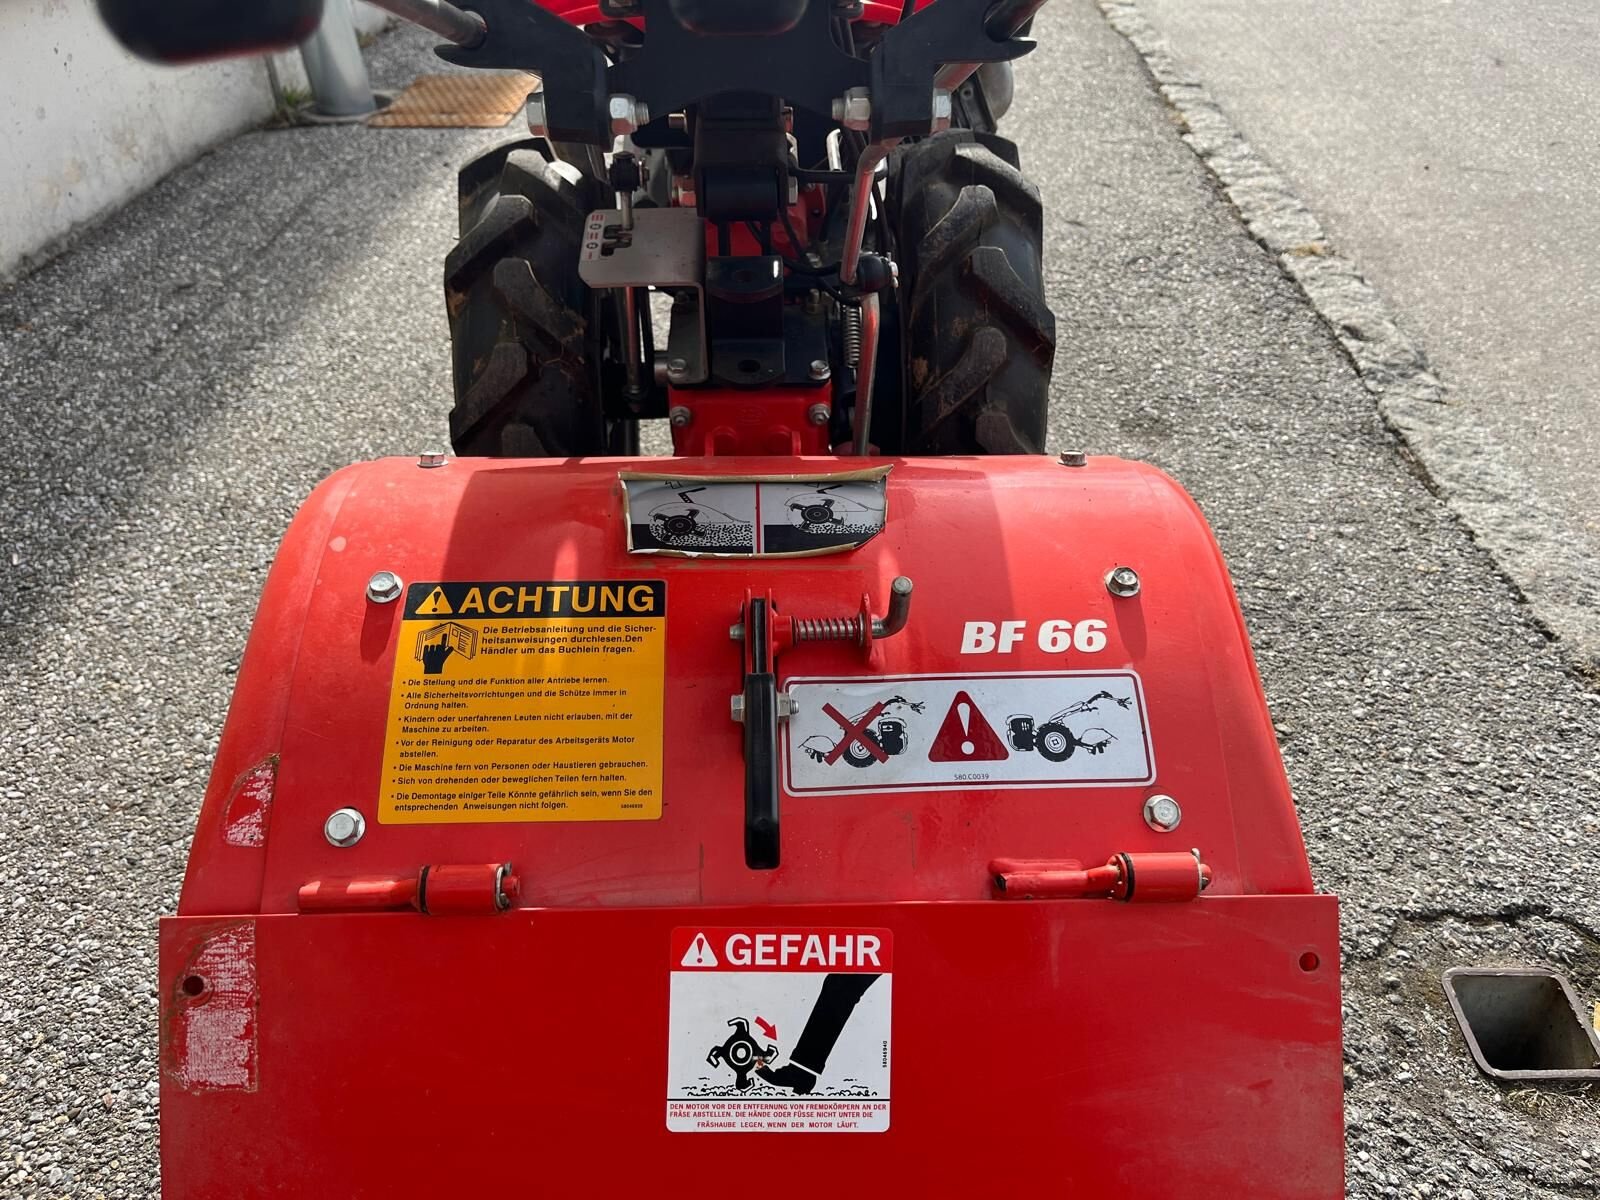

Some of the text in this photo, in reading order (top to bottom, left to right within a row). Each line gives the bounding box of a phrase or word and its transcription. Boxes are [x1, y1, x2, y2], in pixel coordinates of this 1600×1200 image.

[458, 585, 654, 614] ACHTUNG
[502, 625, 584, 634] Betriebsanleitung
[481, 636, 568, 644] heitsanweisungen
[960, 619, 1108, 654] BF 66
[603, 646, 635, 654] fragen.
[423, 679, 455, 687] Stellung
[424, 691, 524, 699] Sicherheitsvorrichtungen
[404, 702, 439, 710] Ordnung
[431, 739, 473, 747] Reinigung
[496, 738, 536, 746] Reparatur
[555, 736, 609, 745] Arbeitsgeräts
[599, 761, 648, 770] gebrauchen.
[502, 775, 553, 784] beweglichen
[411, 792, 456, 801] Demontage
[458, 792, 486, 800] einiger
[538, 790, 578, 799] gefährlich
[394, 804, 458, 812] entsprechenden
[541, 802, 568, 810] folgen.
[725, 933, 880, 966] GEFAHR
